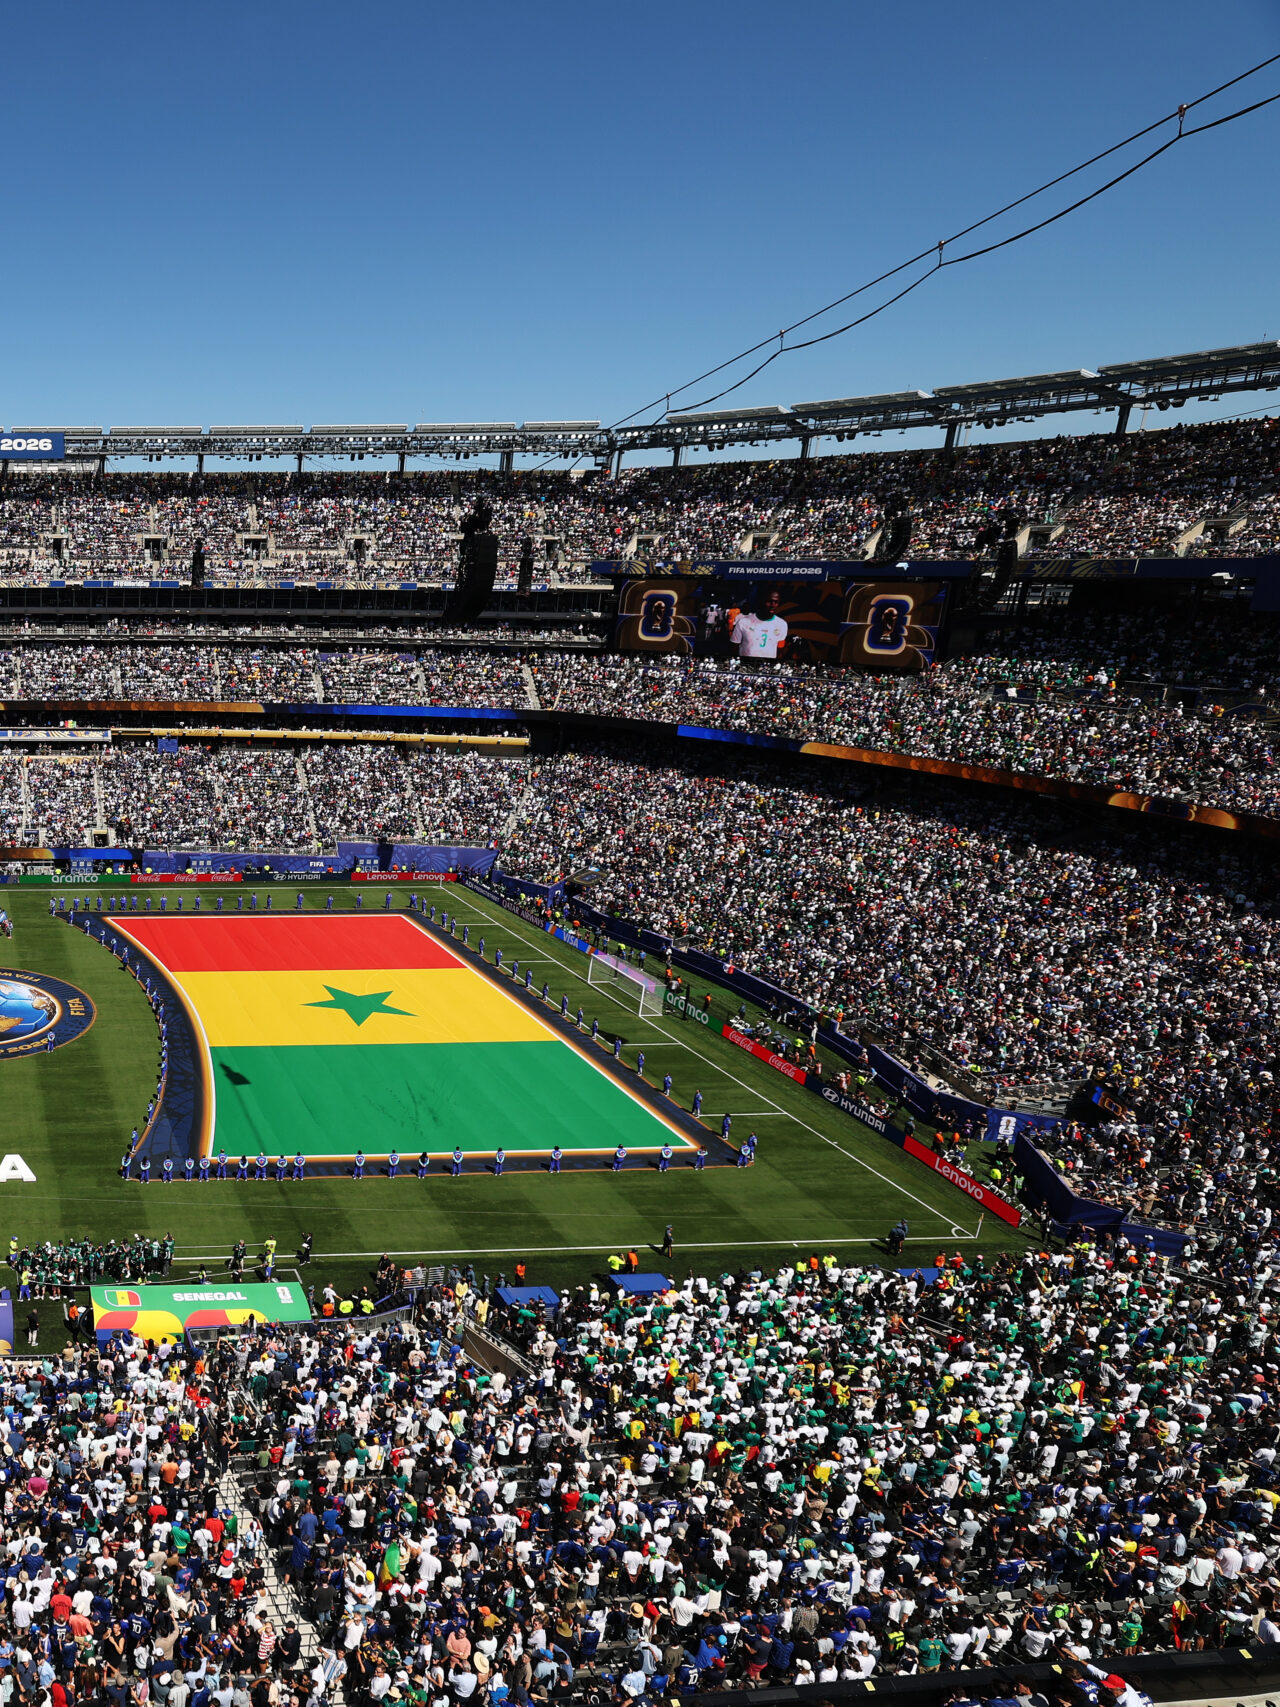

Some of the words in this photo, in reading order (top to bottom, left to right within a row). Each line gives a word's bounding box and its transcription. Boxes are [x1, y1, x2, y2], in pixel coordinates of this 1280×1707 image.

[0, 438, 53, 451] 2026
[792, 567, 823, 575] 2026
[760, 633, 768, 648] 3
[51, 874, 99, 883] aramco
[366, 872, 398, 880] Lenovo
[412, 872, 445, 880] Lenovo
[501, 900, 520, 915] QATAR
[520, 911, 545, 928] AIRWAYS
[562, 931, 579, 948] VISA
[67, 997, 86, 1016] FIFA
[666, 992, 709, 1024] aramco
[840, 1097, 886, 1133] HYUNDAI
[934, 1156, 984, 1200] Lenovo
[172, 1291, 248, 1301] SENEGAL
[132, 1624, 142, 1634] 10
[1132, 1631, 1138, 1639] 3
[688, 1673, 698, 1684] 10
